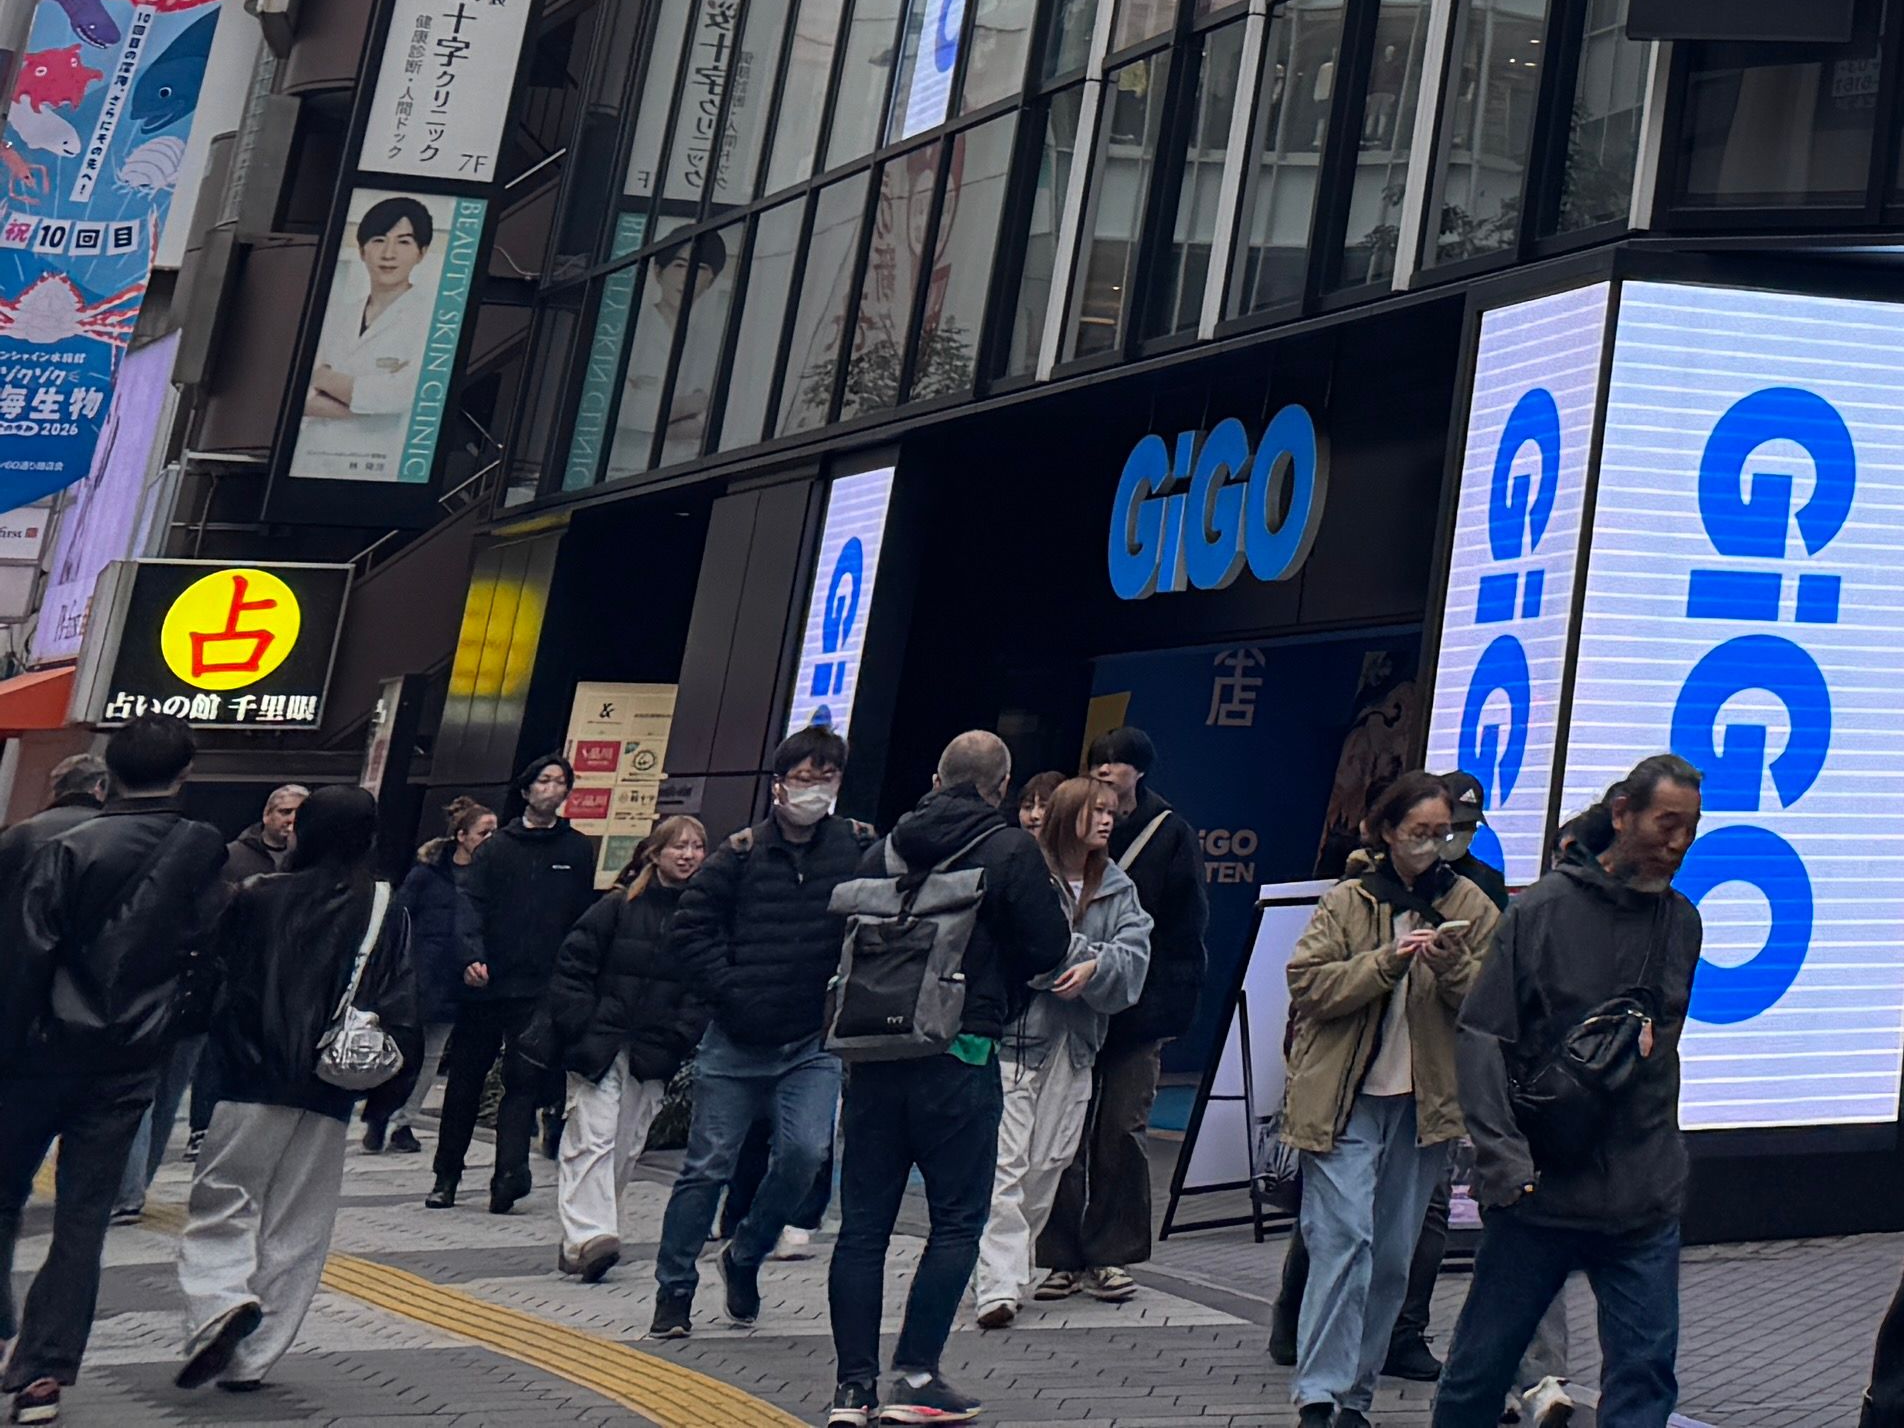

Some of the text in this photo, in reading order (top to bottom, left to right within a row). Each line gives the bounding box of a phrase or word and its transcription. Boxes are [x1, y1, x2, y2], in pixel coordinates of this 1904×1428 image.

[388, 13, 433, 160] 健康診断・人間ドック
[457, 154, 488, 174] 7F
[403, 201, 482, 478] BEAUTY SKIN CLINIC
[40, 423, 79, 436] 2026
[1108, 404, 1320, 601] GiGO
[189, 574, 278, 679] 占
[1458, 387, 1560, 874] GiG
[228, 694, 319, 721] 千里眼
[1670, 387, 1856, 1024] GiGO
